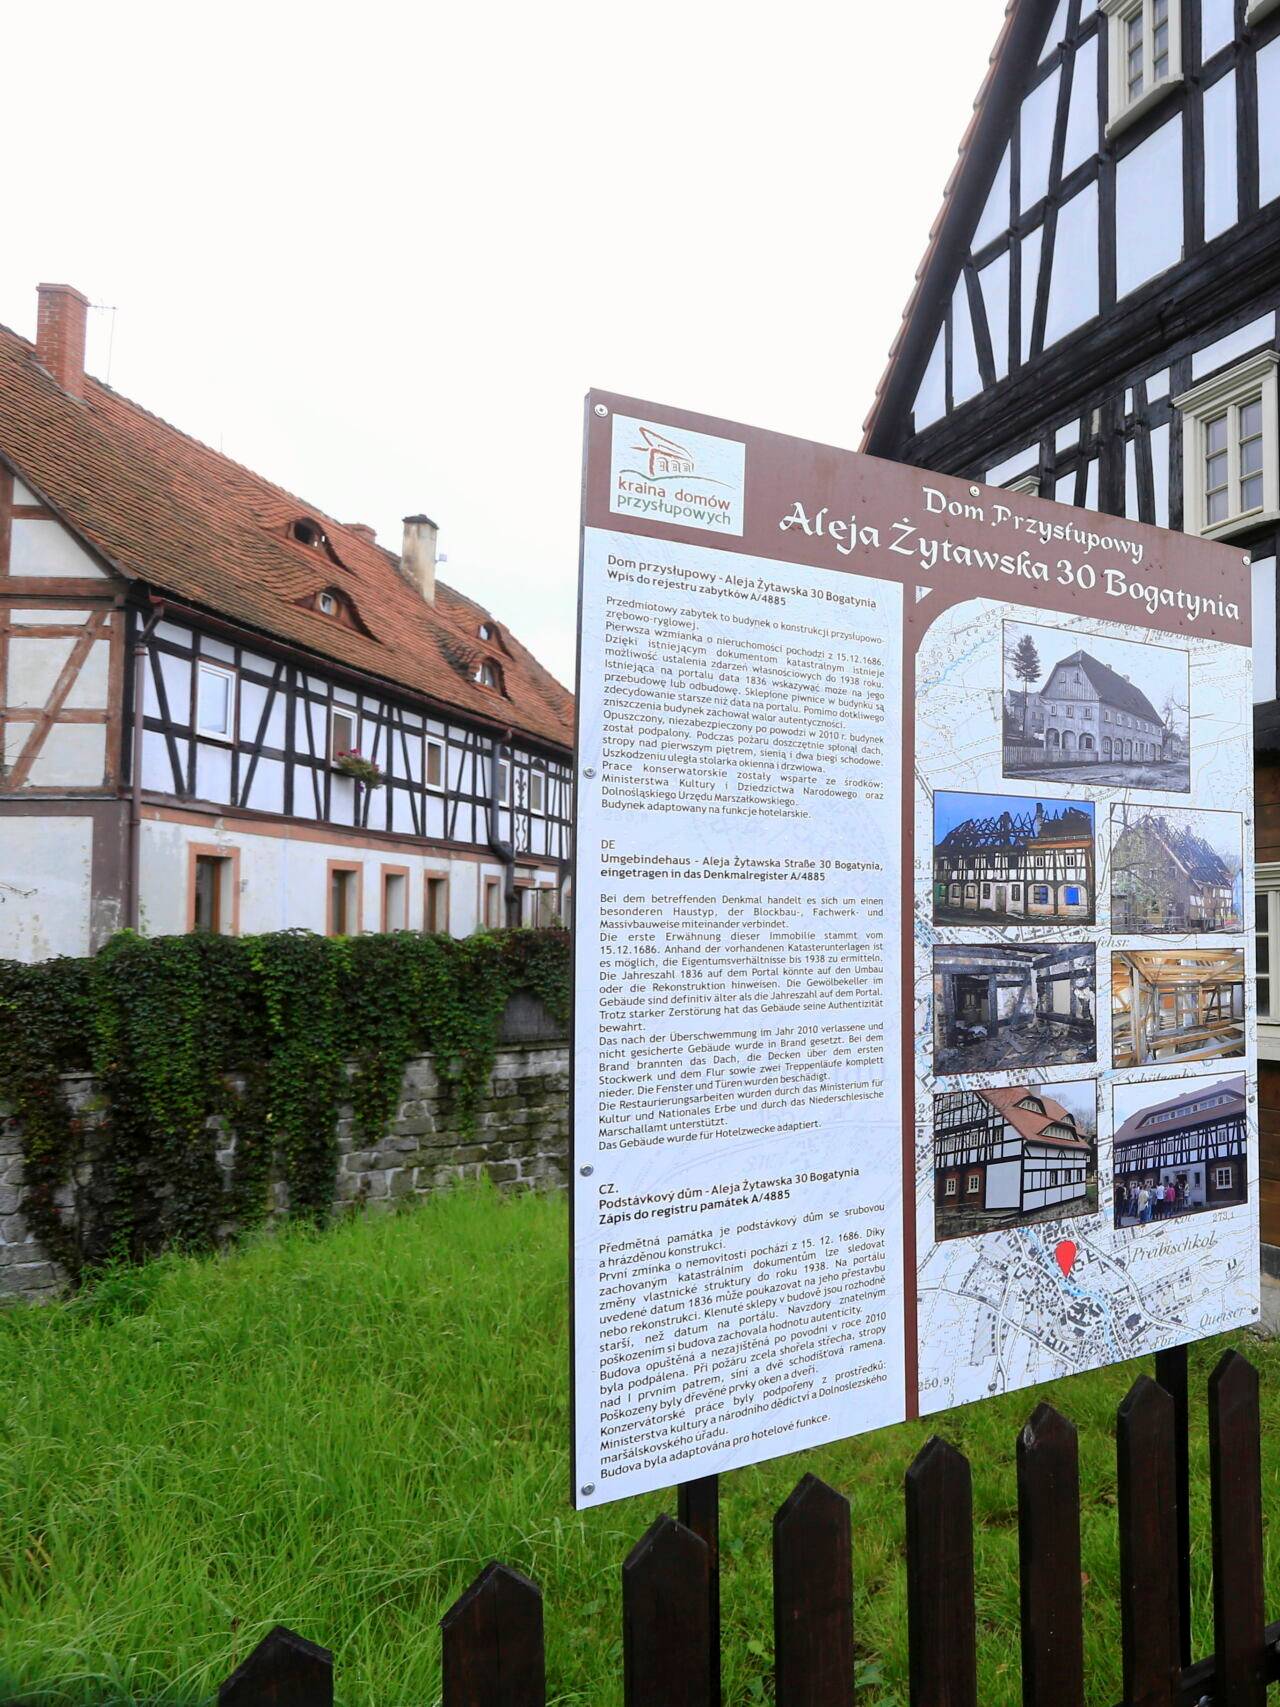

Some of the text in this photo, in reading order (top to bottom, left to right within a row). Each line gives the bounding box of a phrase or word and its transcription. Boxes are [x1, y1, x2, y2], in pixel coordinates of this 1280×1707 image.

[618, 476, 731, 511] kraina domów
[617, 494, 731, 525] przysłupowych
[922, 486, 1145, 565] Dom Przysłupowy
[777, 500, 1241, 624] Aleja Żytawska 30 Bogatynia
[607, 554, 876, 608] Dom przysłupowy Aleja Żytawska 30 Bogatynia
[607, 568, 786, 606] Wpis do rejestru zabytków A/4885
[605, 620, 884, 667] Pierwsza wzmianka o nieruchomości pochodzi z 15.12.1686.
[604, 647, 657, 661] możliwość
[662, 655, 707, 667] ustalenia
[711, 660, 748, 672] zdarzeń
[825, 673, 836, 683] do
[840, 675, 860, 686] 1938
[863, 679, 884, 688] roku.
[603, 684, 885, 723] zdecydowanie starsze niż data na portalu. Pomimo dotkliwego
[603, 698, 846, 729] zniszczenia budynek zachował walor autentyczności.
[601, 773, 884, 800] Ministerstwa Kultury i Dziedzictwa Narodowego oraz
[601, 785, 798, 808] Dolnośląskiego Urzędu Marszałkowskiego.
[601, 798, 811, 818] Budynek adaptowany na funkcje hotelarskie.
[600, 839, 615, 850] DE
[600, 853, 883, 872] Umgebindehaus Aleja Żytawska Straße 30 Bogatynia,
[600, 867, 826, 882] eingetragen in das Denkmalregister A/4885
[599, 919, 789, 929] Massivbauweise miteinander verbindet.
[599, 932, 618, 942] Die
[627, 933, 656, 942] erste
[665, 931, 721, 943] Erwähnung
[730, 931, 760, 941] dieser
[769, 931, 816, 940] Immobilie
[824, 931, 858, 940] stammt
[598, 987, 883, 1007] Gebäude sind definitiv älter als die Jahreszahl auf dem Portal.
[599, 1021, 884, 1046] Das nach der Überschwemmung im Jahr 2010 verlassene und
[598, 1117, 728, 1137] Marschallamt unterstützt.
[598, 1120, 821, 1151] Das Gebäude wurde für Hotelzwecke adaptiert.
[598, 1182, 619, 1195] CZ.
[598, 1167, 860, 1210] Podstávkový dům Aleja Żytawska 30 Bogatynia
[598, 1188, 790, 1226] Zápis do registru památek A/4885
[599, 1204, 885, 1254] Předmětná památka je podstávkový dům se srubovou
[598, 1260, 606, 1268] a
[607, 1250, 666, 1267] hrázděnou
[599, 1251, 886, 1311] změny vlastnické struktury do roku 1938. Na portálu
[600, 1426, 729, 1465] maršálskovského úřadu.
[600, 1414, 831, 1479] Budova byla adaptována pro hotelové funkce.
